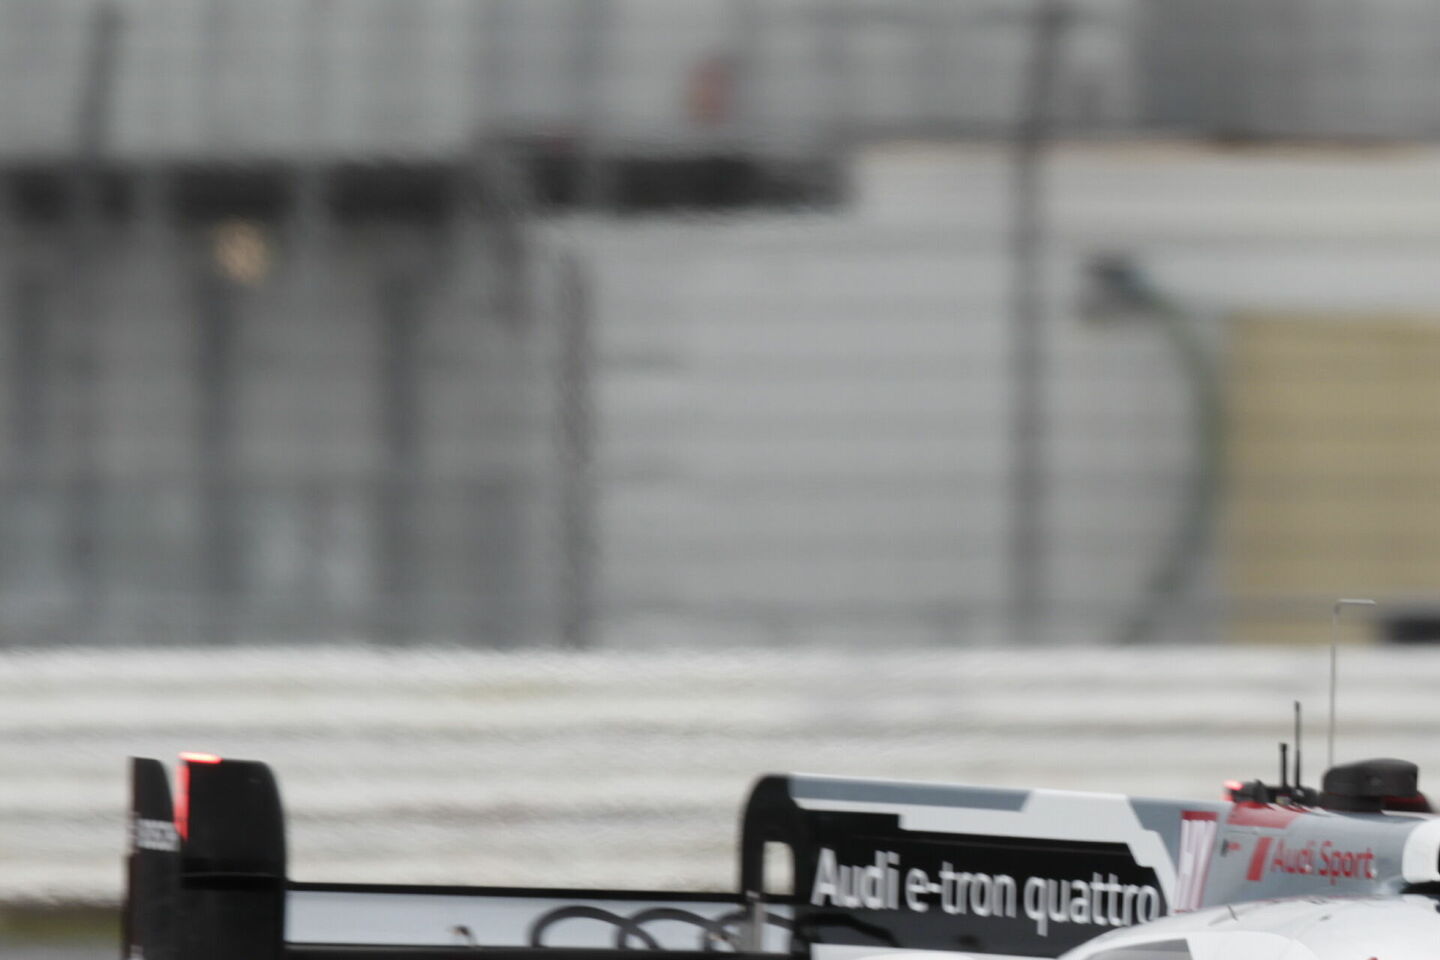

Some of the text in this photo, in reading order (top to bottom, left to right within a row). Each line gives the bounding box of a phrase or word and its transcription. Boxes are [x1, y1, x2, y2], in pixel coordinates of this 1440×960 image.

[810, 847, 1161, 937] Audi e-tron quattro
[1271, 838, 1374, 885] Audi Sport
